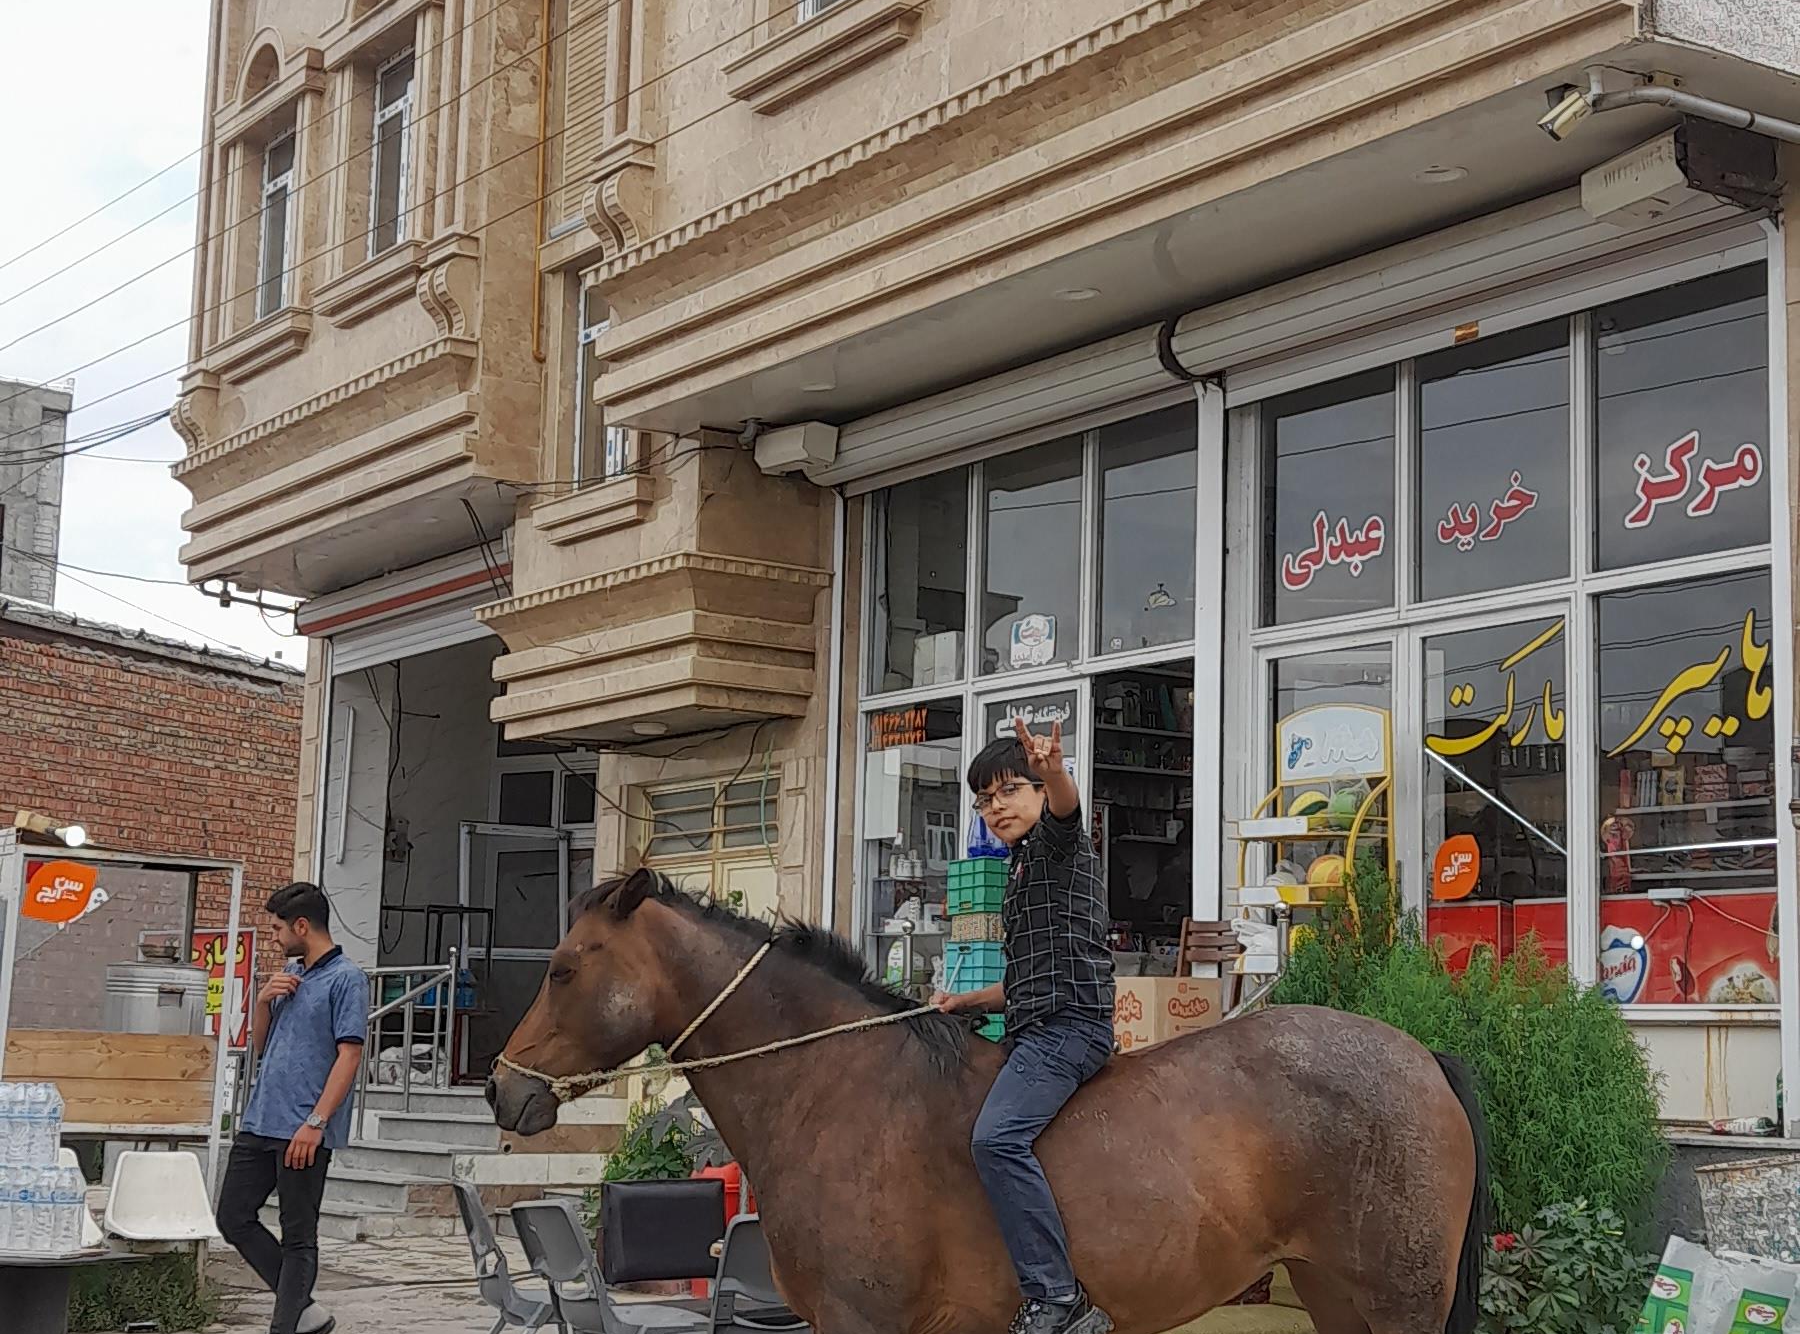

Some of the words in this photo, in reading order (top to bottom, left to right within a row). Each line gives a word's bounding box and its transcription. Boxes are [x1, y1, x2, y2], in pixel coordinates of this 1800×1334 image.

[1438, 470, 1539, 551] خرید
[1624, 430, 1763, 529] مرکز
[1281, 510, 1385, 590] عبدلی
[1424, 617, 1566, 757] مارکت
[1606, 608, 1773, 759] هایپر
